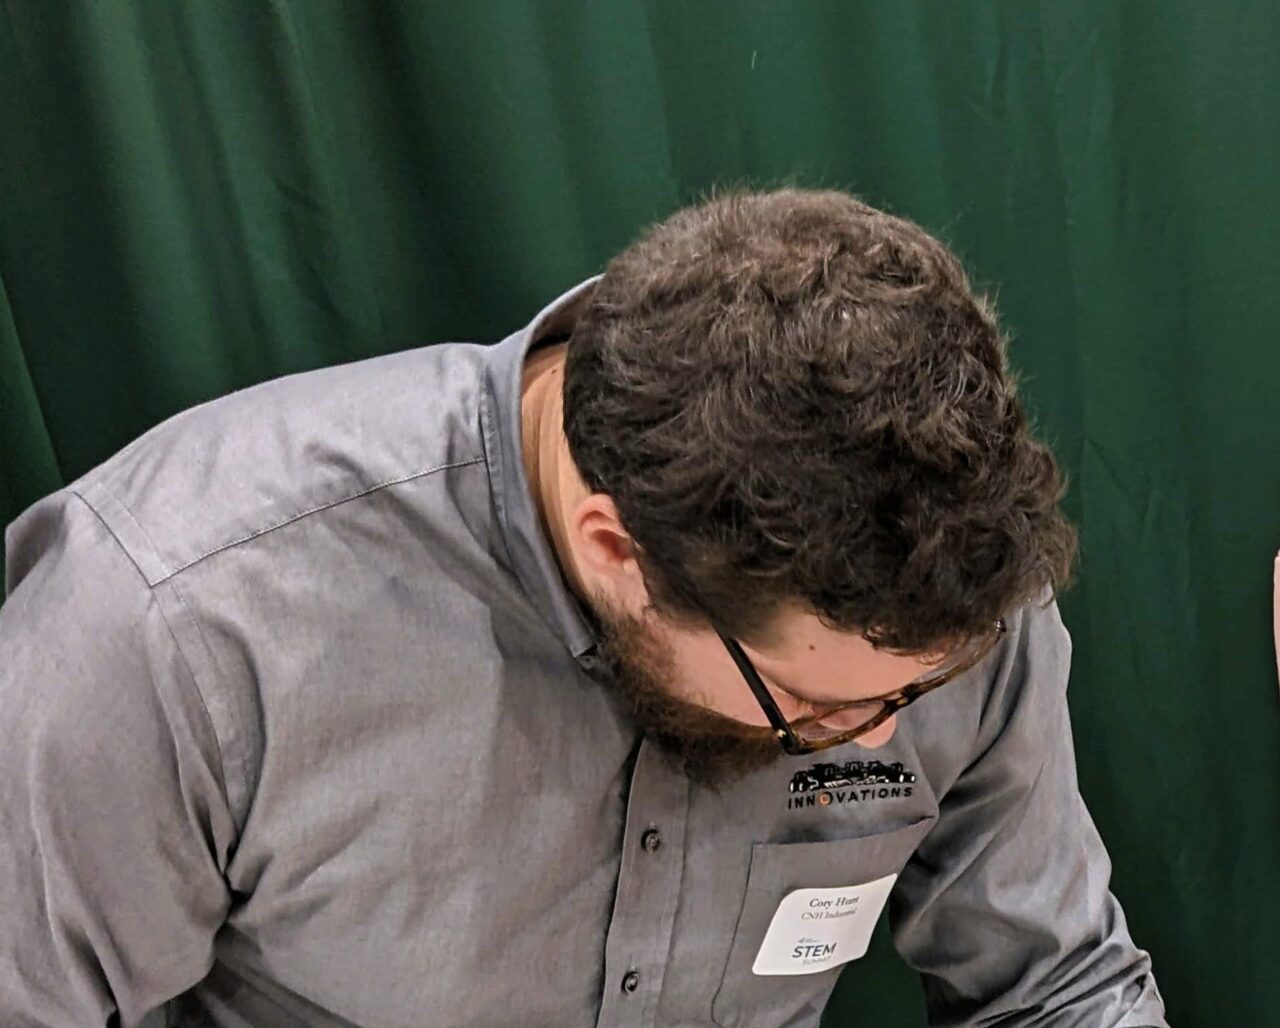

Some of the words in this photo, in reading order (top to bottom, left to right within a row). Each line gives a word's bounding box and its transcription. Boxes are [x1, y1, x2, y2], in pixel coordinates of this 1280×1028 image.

[788, 787, 913, 810] INNOVATIONS
[809, 898, 833, 910] Cory
[801, 911, 824, 920] CNH
[792, 942, 838, 959] STEM
